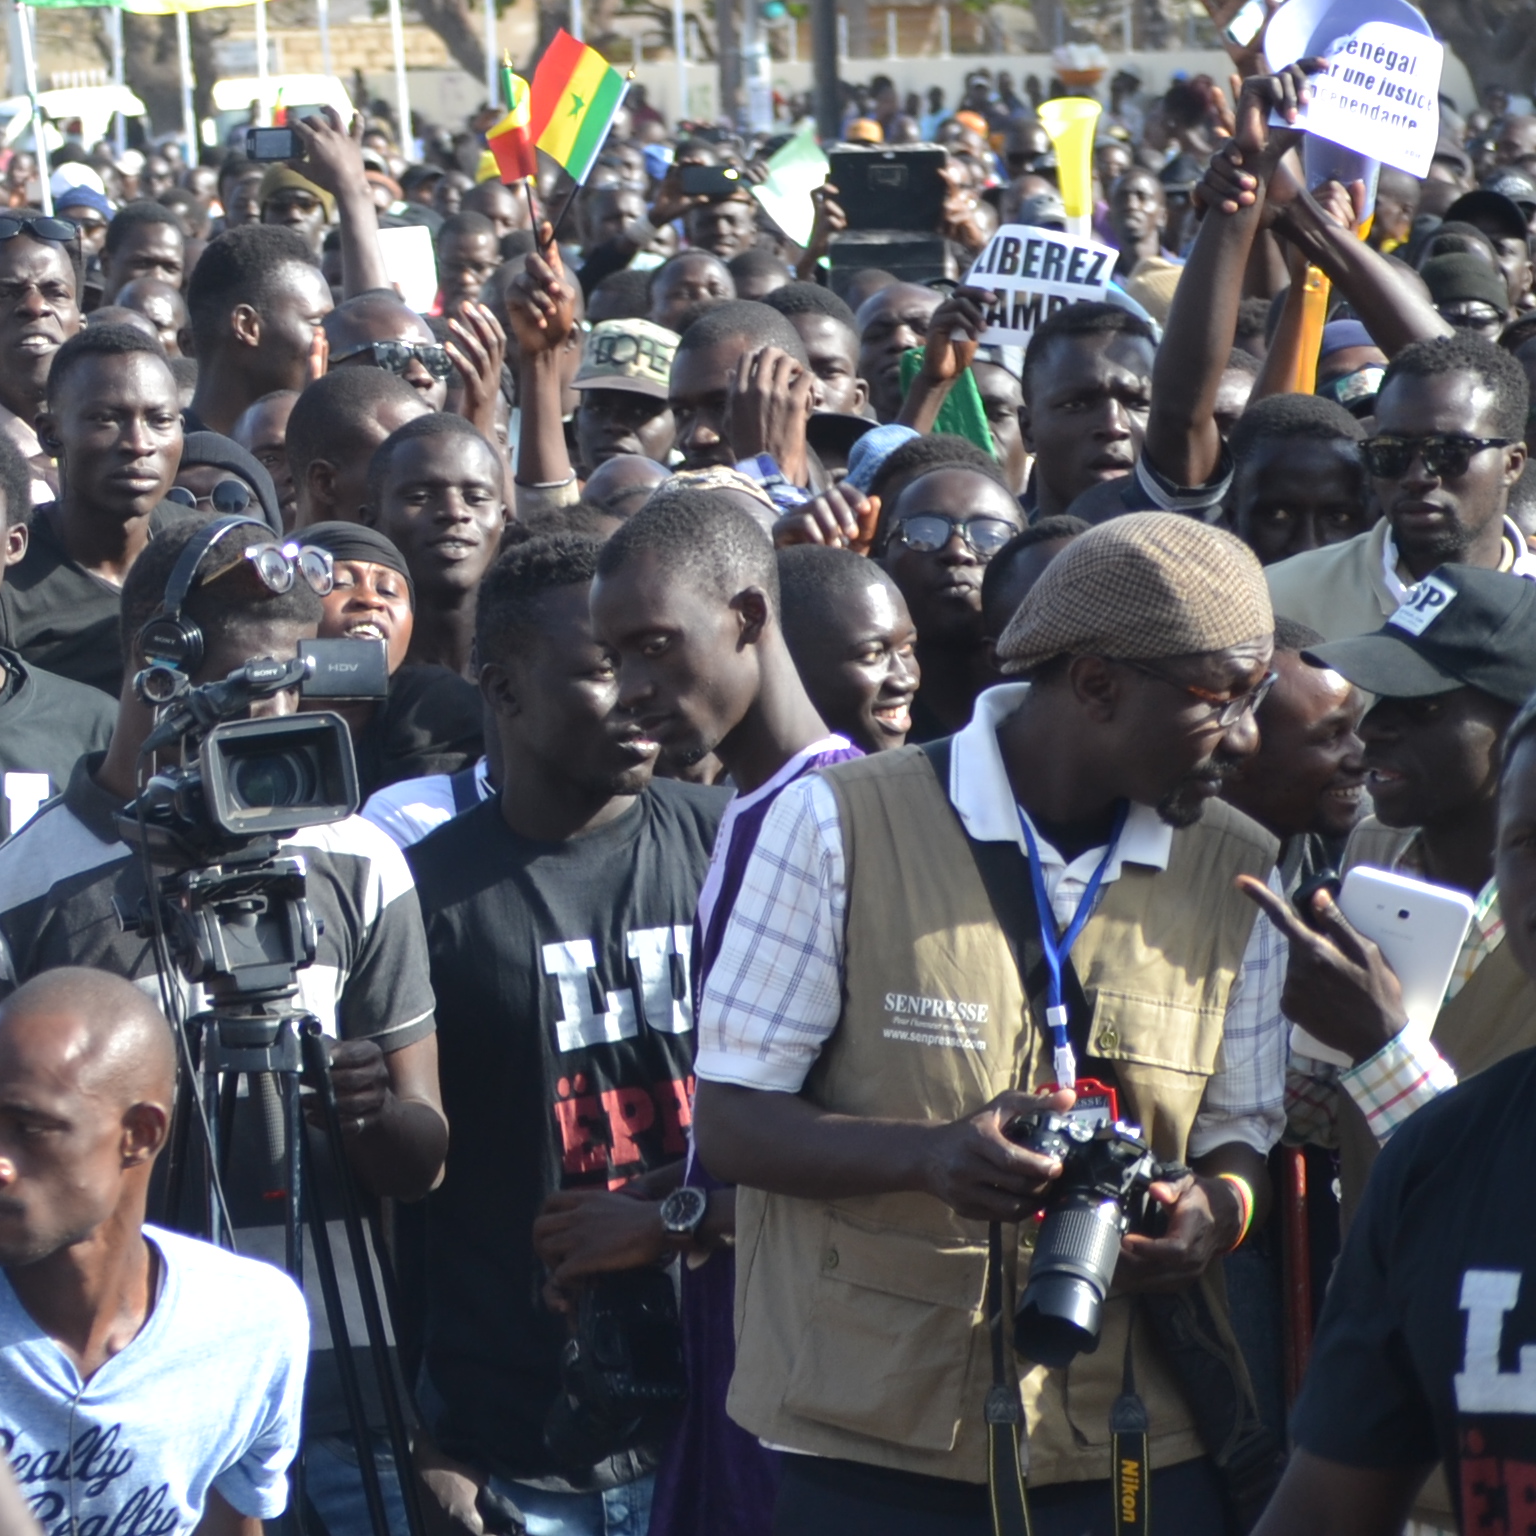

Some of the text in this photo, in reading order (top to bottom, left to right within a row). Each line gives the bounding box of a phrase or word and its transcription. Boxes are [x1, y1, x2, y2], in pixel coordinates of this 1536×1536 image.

[1343, 67, 1375, 90] une
[974, 236, 1109, 287] LIBEREZ
[154, 635, 176, 645] SONY
[253, 668, 278, 677] SONY
[328, 663, 359, 672] HDV
[884, 992, 989, 1023] SENPRESSE
[883, 1027, 987, 1051] www.senpresse.com
[1121, 1459, 1139, 1523] Nikon
